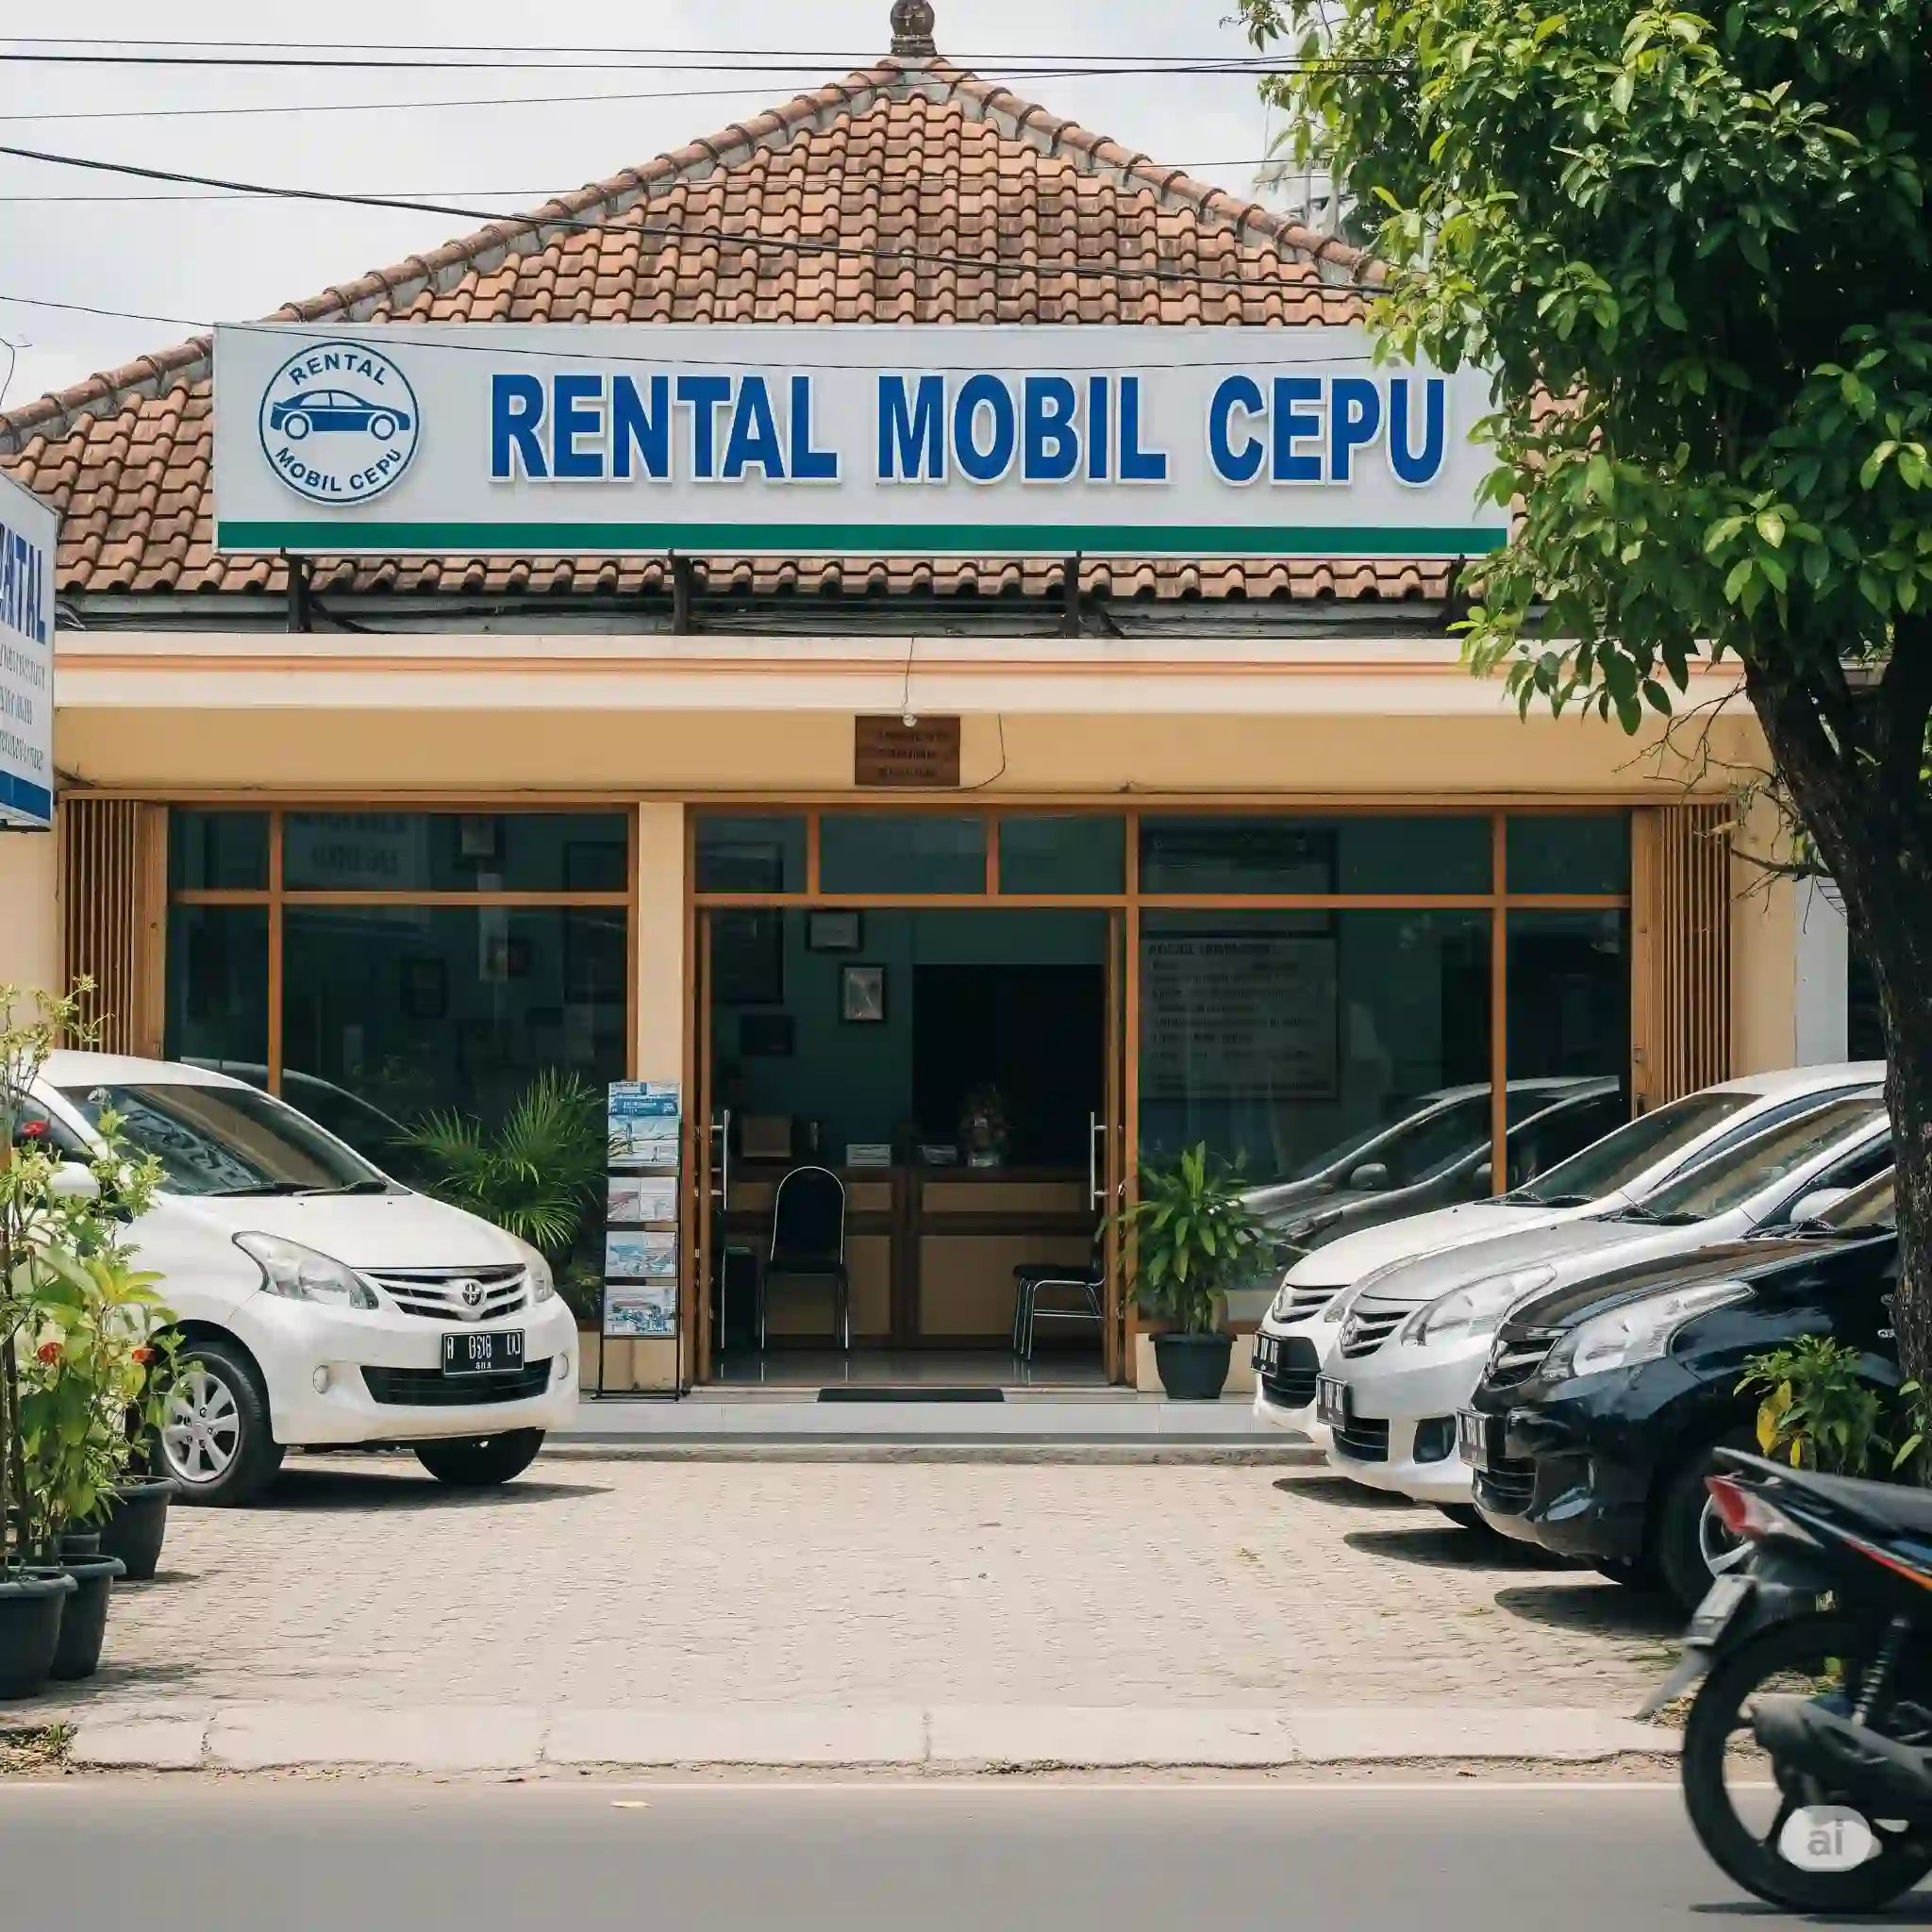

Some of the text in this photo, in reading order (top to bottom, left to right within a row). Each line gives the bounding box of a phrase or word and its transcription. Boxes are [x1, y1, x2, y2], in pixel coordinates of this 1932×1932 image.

[289, 352, 386, 386] RENTAL
[490, 374, 1446, 484] RENTAL MOBIL CEPU
[275, 446, 402, 491] MOBIL CEPU
